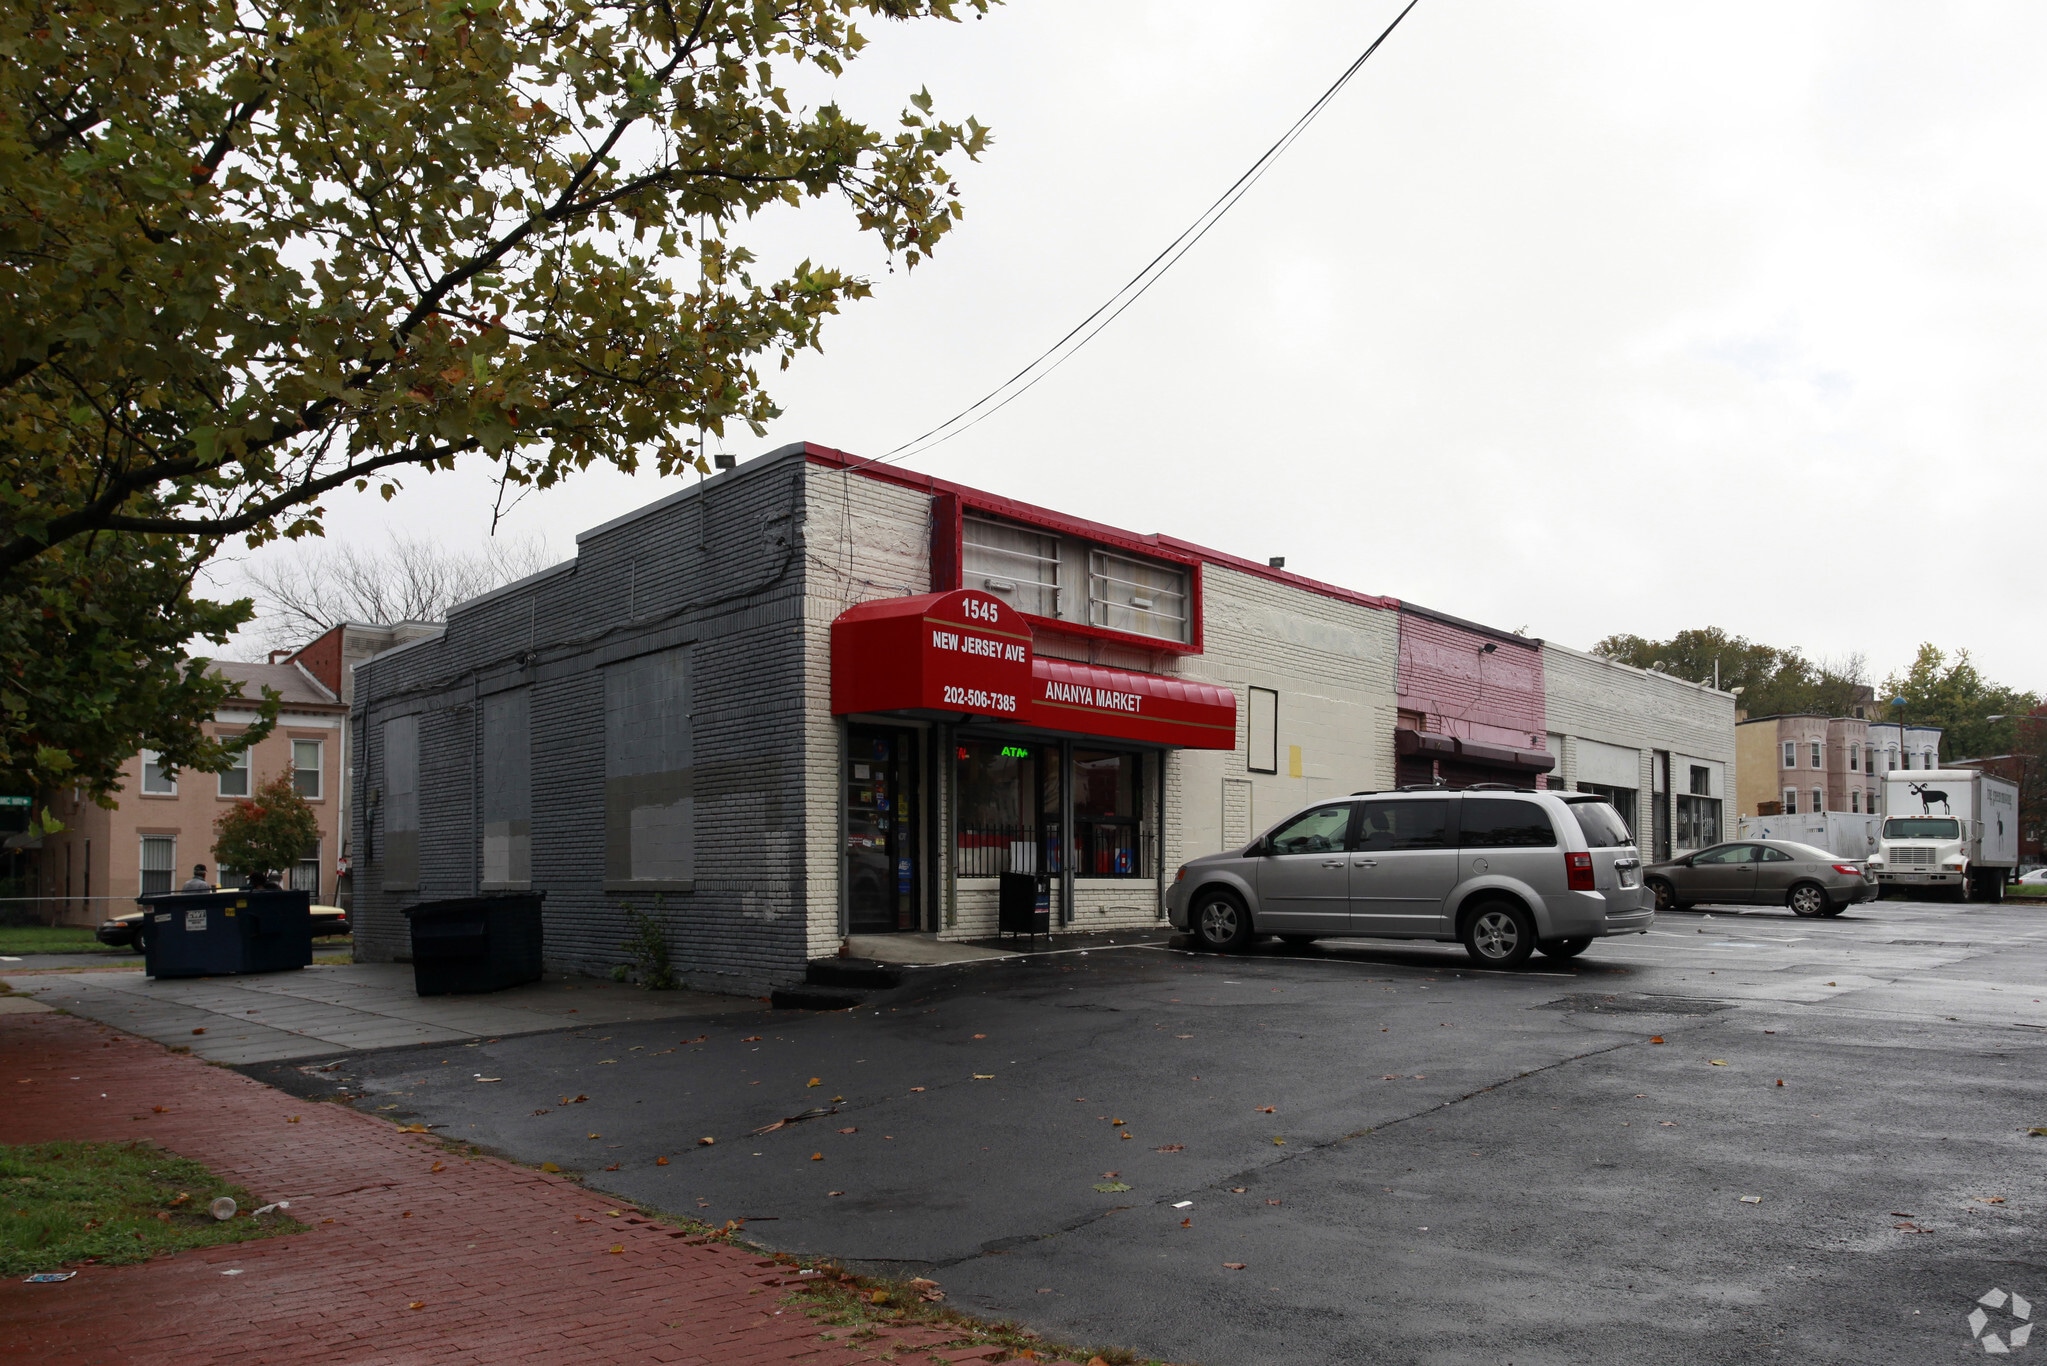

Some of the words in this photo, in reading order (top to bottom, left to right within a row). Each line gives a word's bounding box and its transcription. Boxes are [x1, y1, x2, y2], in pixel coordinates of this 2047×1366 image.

[962, 598, 998, 623] 1545
[933, 630, 959, 651] NEW
[961, 636, 1003, 658] JERSEY
[1005, 644, 1025, 663] AVE
[944, 685, 1016, 712] 202-506-7385
[1045, 681, 1093, 706] ANANYA
[1096, 688, 1142, 712] MARKET
[1001, 746, 1027, 758] ATM
